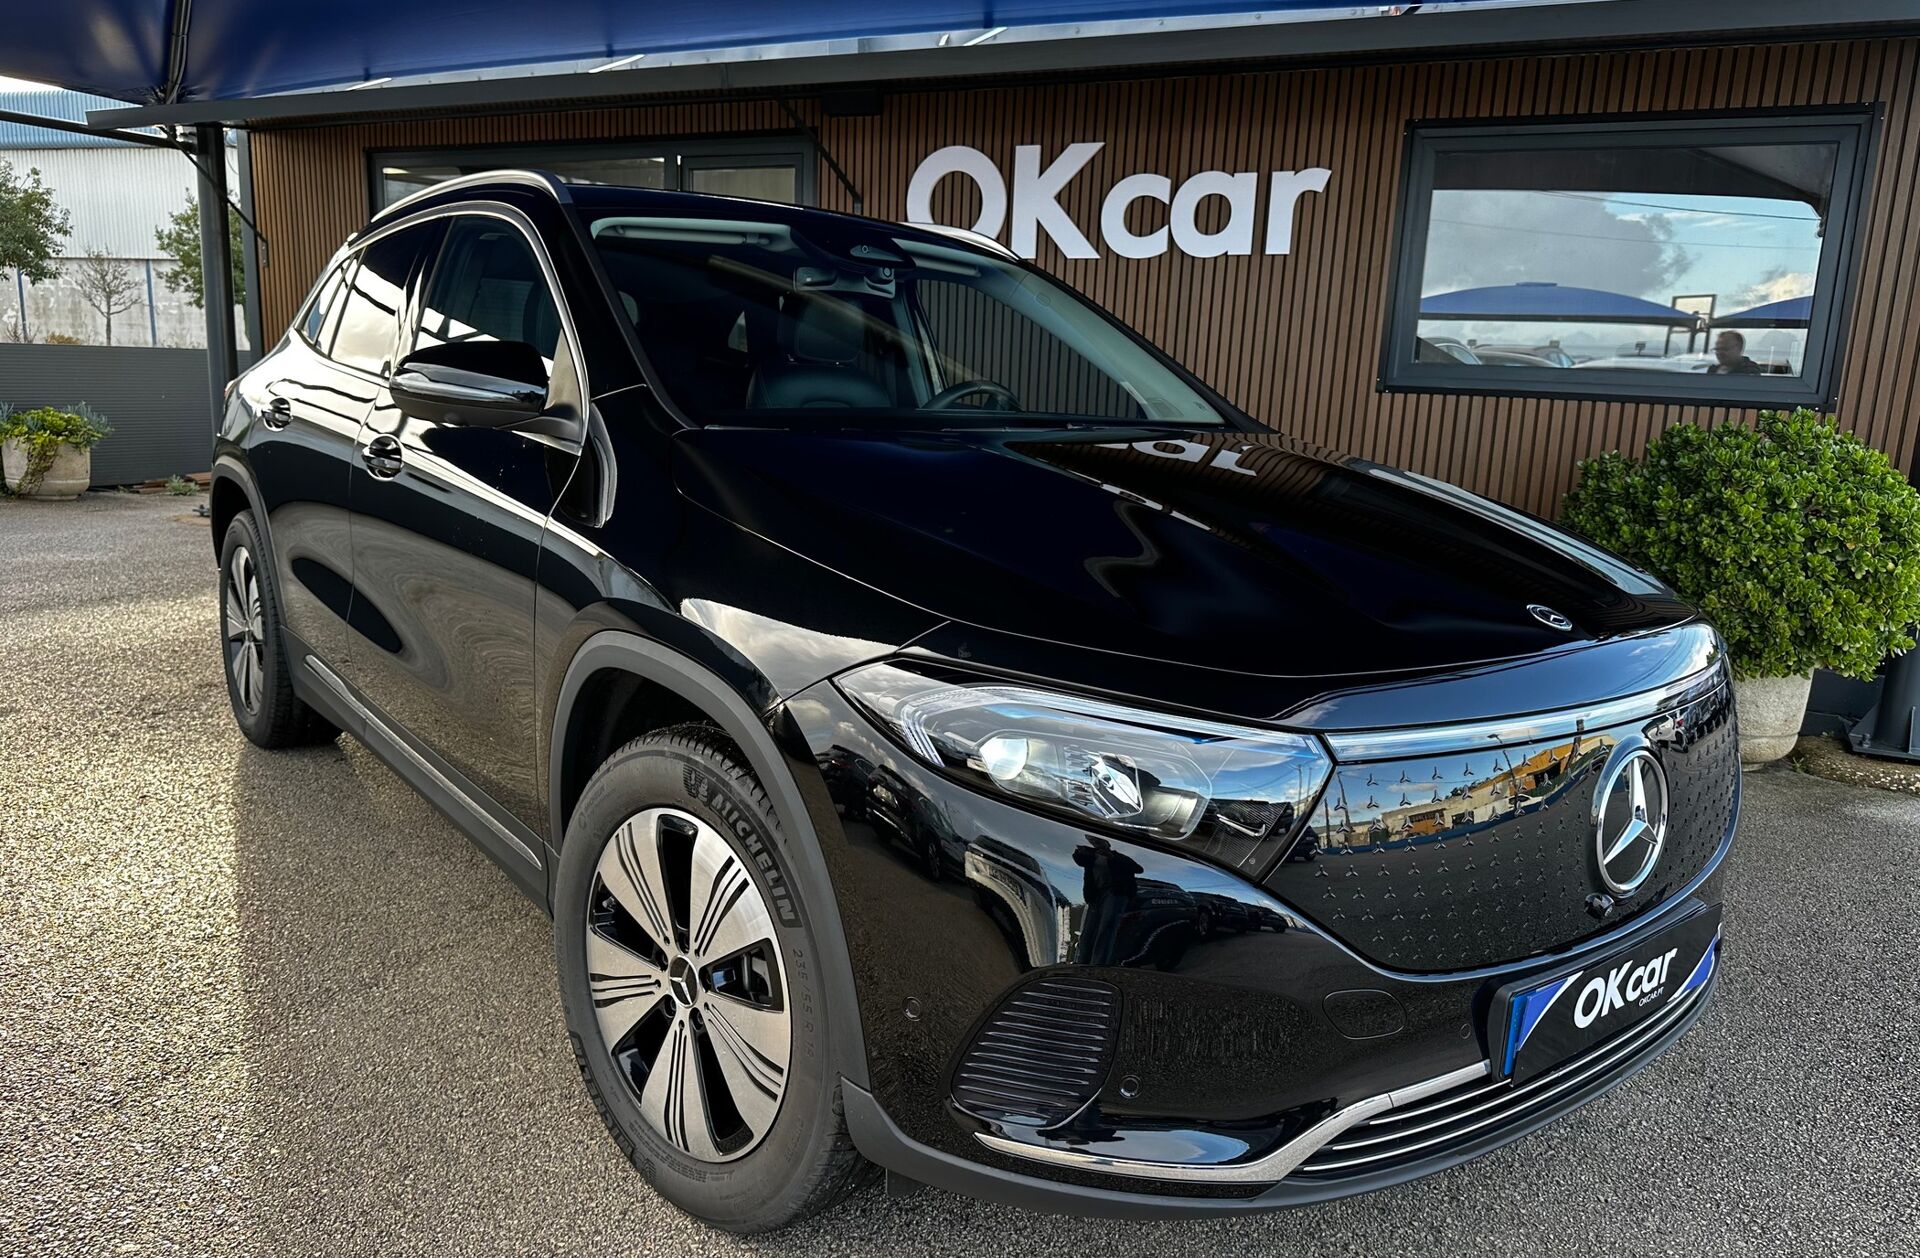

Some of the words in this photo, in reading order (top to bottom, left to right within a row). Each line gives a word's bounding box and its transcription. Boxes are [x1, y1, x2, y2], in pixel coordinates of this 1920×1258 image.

[906, 141, 1332, 259] OKcar
[711, 793, 796, 920] MICHELIN
[1573, 947, 1678, 1029] OKcar
